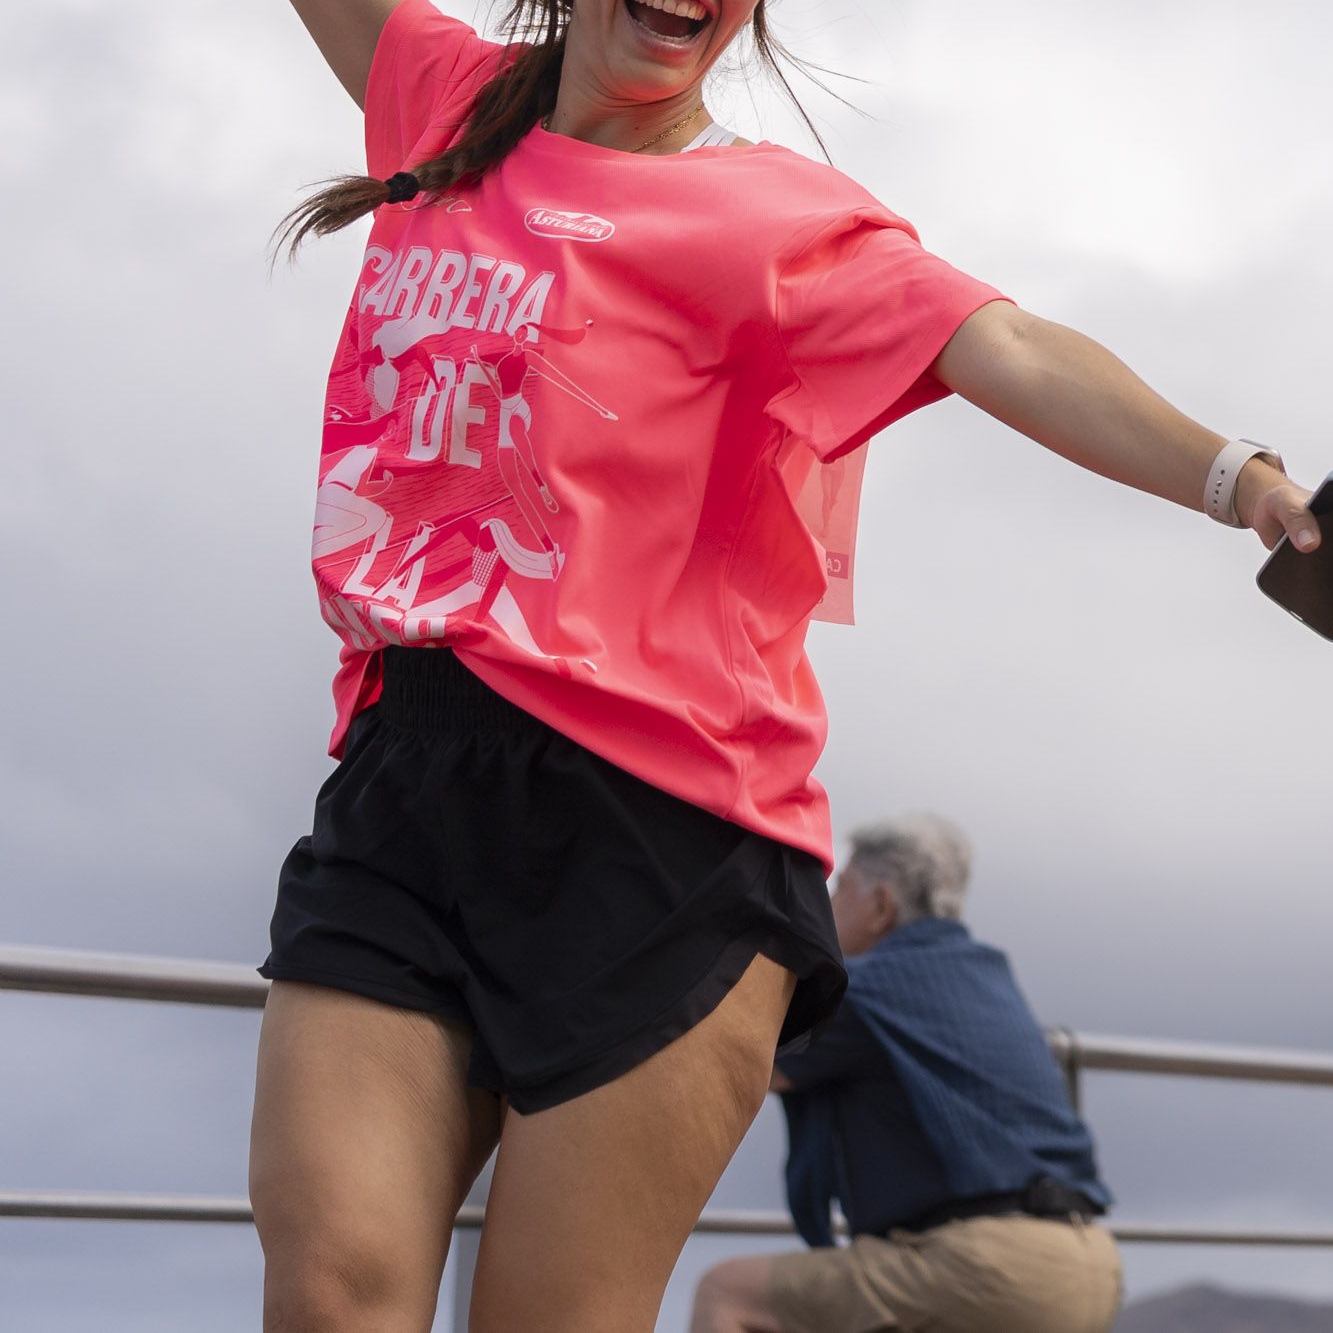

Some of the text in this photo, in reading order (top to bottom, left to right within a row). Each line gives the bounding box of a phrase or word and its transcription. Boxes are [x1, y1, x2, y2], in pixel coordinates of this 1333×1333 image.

[528, 210, 604, 238] ASTURIANA
[360, 243, 556, 344] CARRERA
[404, 354, 496, 470] DE
[340, 511, 434, 612] LA
